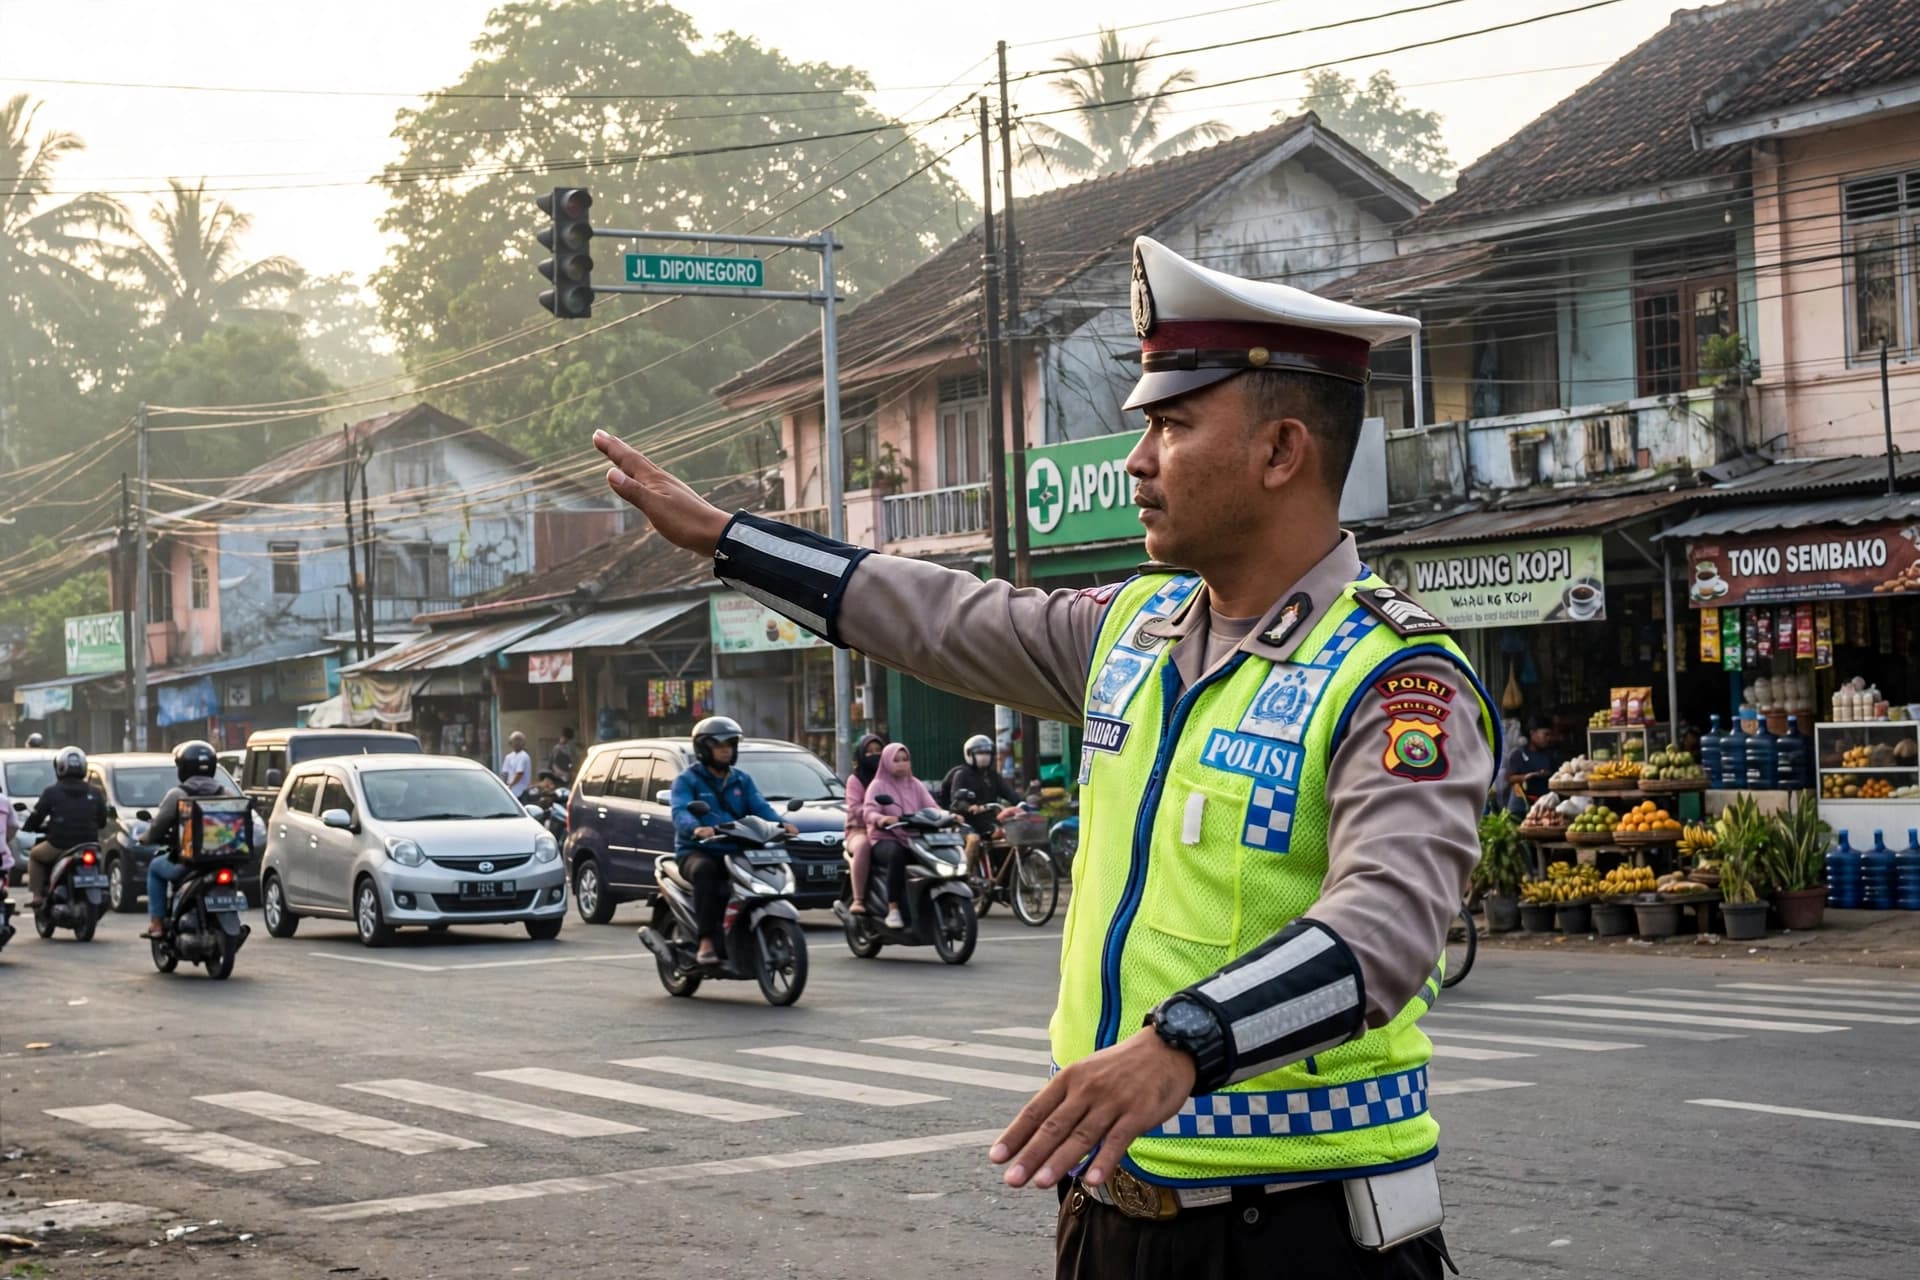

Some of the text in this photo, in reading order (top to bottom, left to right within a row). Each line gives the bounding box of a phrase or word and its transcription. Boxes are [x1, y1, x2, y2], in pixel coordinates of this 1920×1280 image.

[632, 259, 757, 282] JL. DIPONEGORO
[1415, 548, 1571, 592] WARUNG KOPI
[1728, 538, 1887, 576] TOKO SEMBAKO
[1504, 592, 1532, 604] KOPI
[1387, 677, 1446, 696] POLRI
[1205, 733, 1298, 781] POLISI
